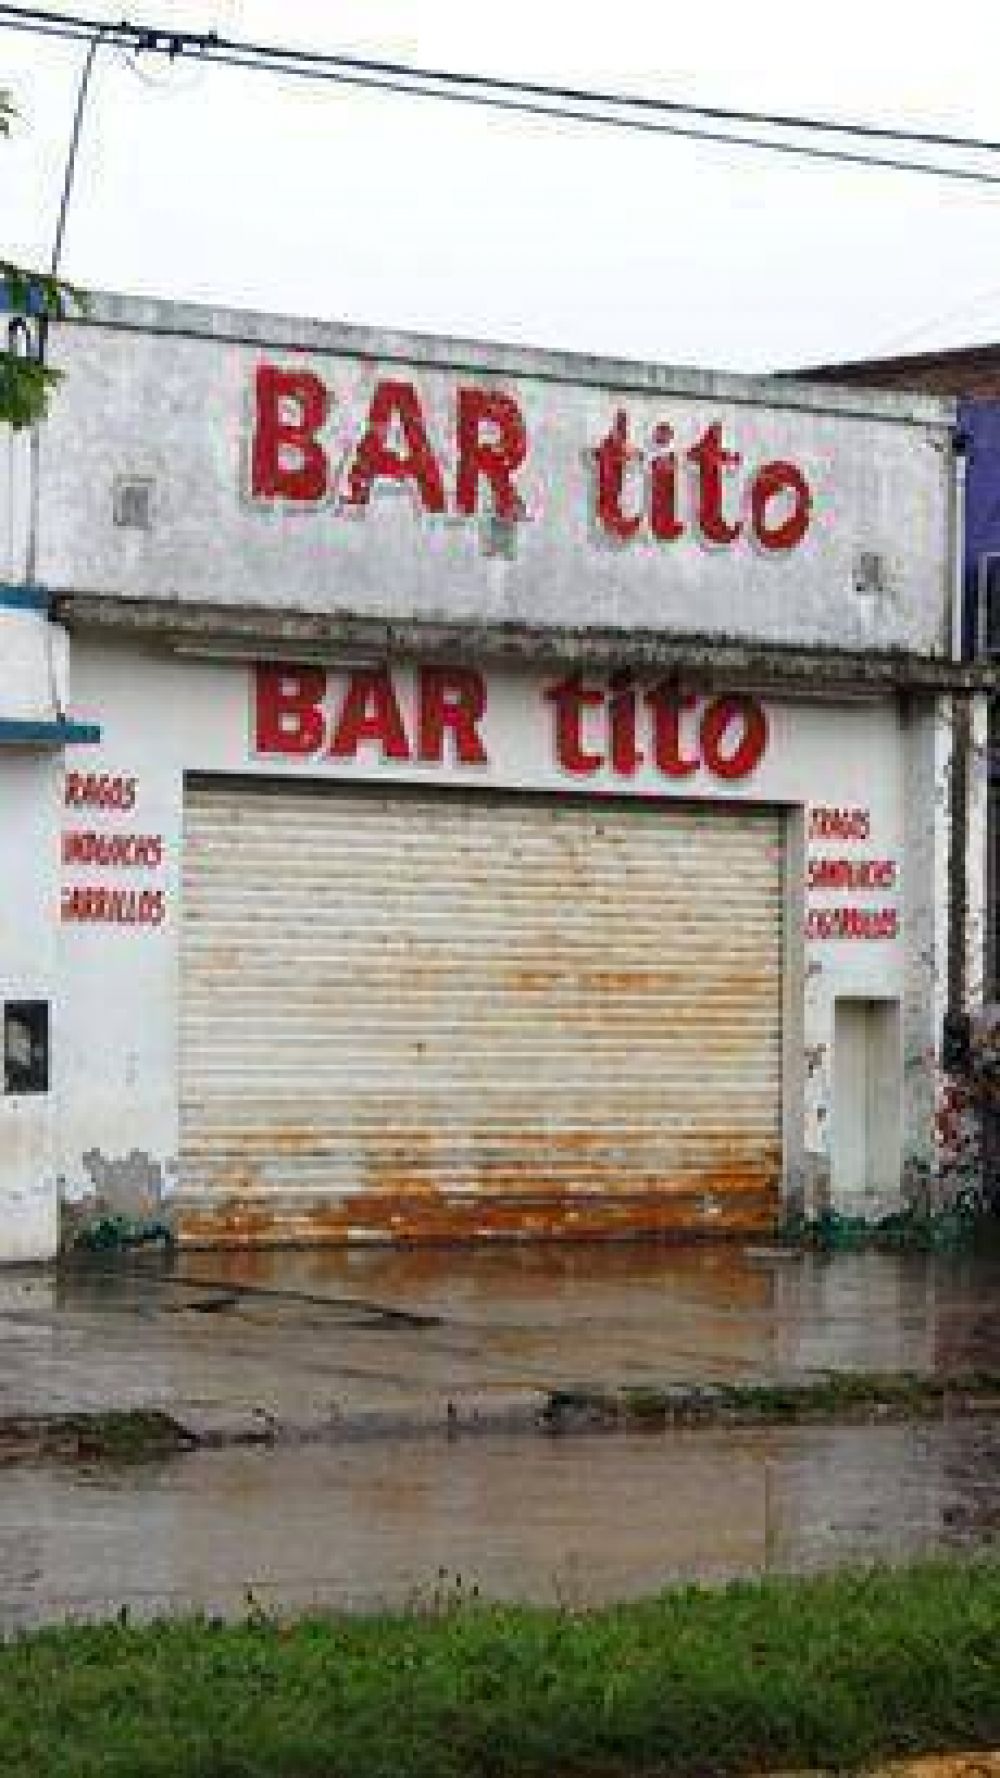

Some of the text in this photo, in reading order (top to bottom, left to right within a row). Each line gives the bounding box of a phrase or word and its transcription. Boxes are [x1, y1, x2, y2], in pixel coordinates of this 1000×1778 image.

[252, 362, 812, 549] BAR tito
[254, 664, 769, 779] BAR tito
